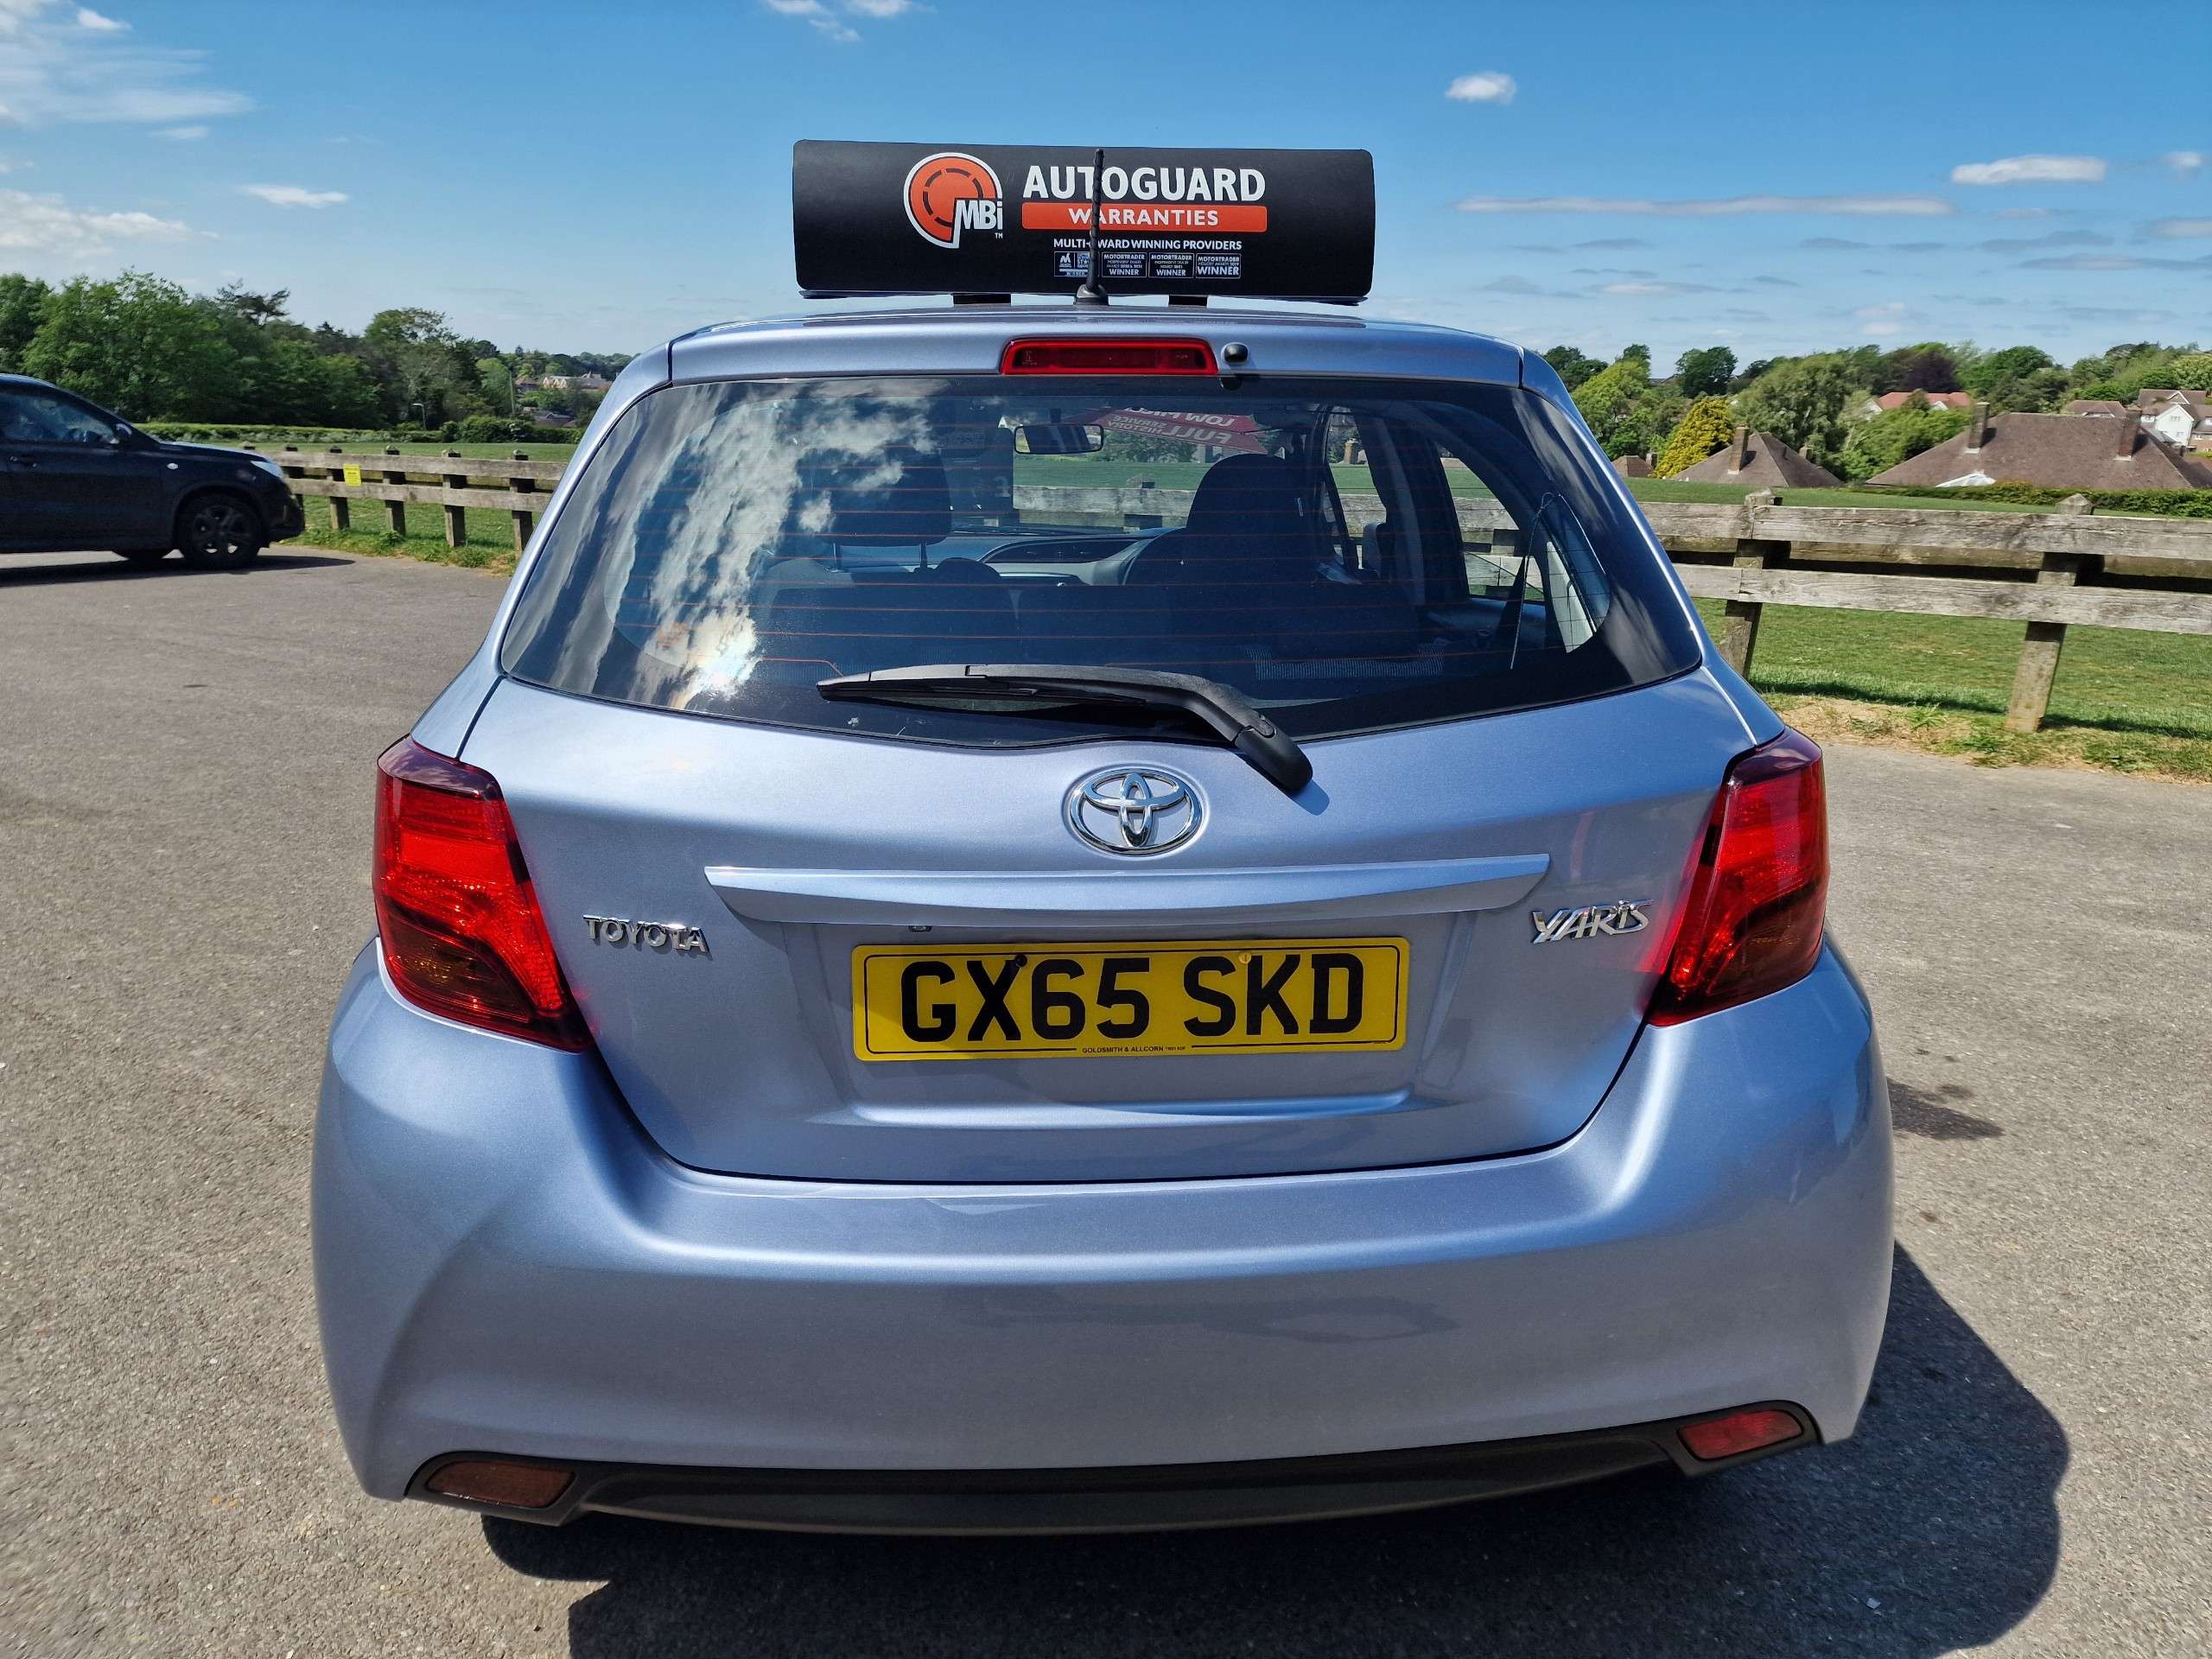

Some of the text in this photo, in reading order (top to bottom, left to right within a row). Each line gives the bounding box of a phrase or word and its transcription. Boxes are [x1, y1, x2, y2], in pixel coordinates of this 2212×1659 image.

[1023, 165, 1267, 201] AUTOGUARD
[1053, 238, 1243, 251] MULTI-WARD WINNING PROVIDERS
[1197, 265, 1240, 276] WINNER
[582, 914, 709, 954] TOYOTA
[900, 953, 1364, 1043] GX65 SKD
